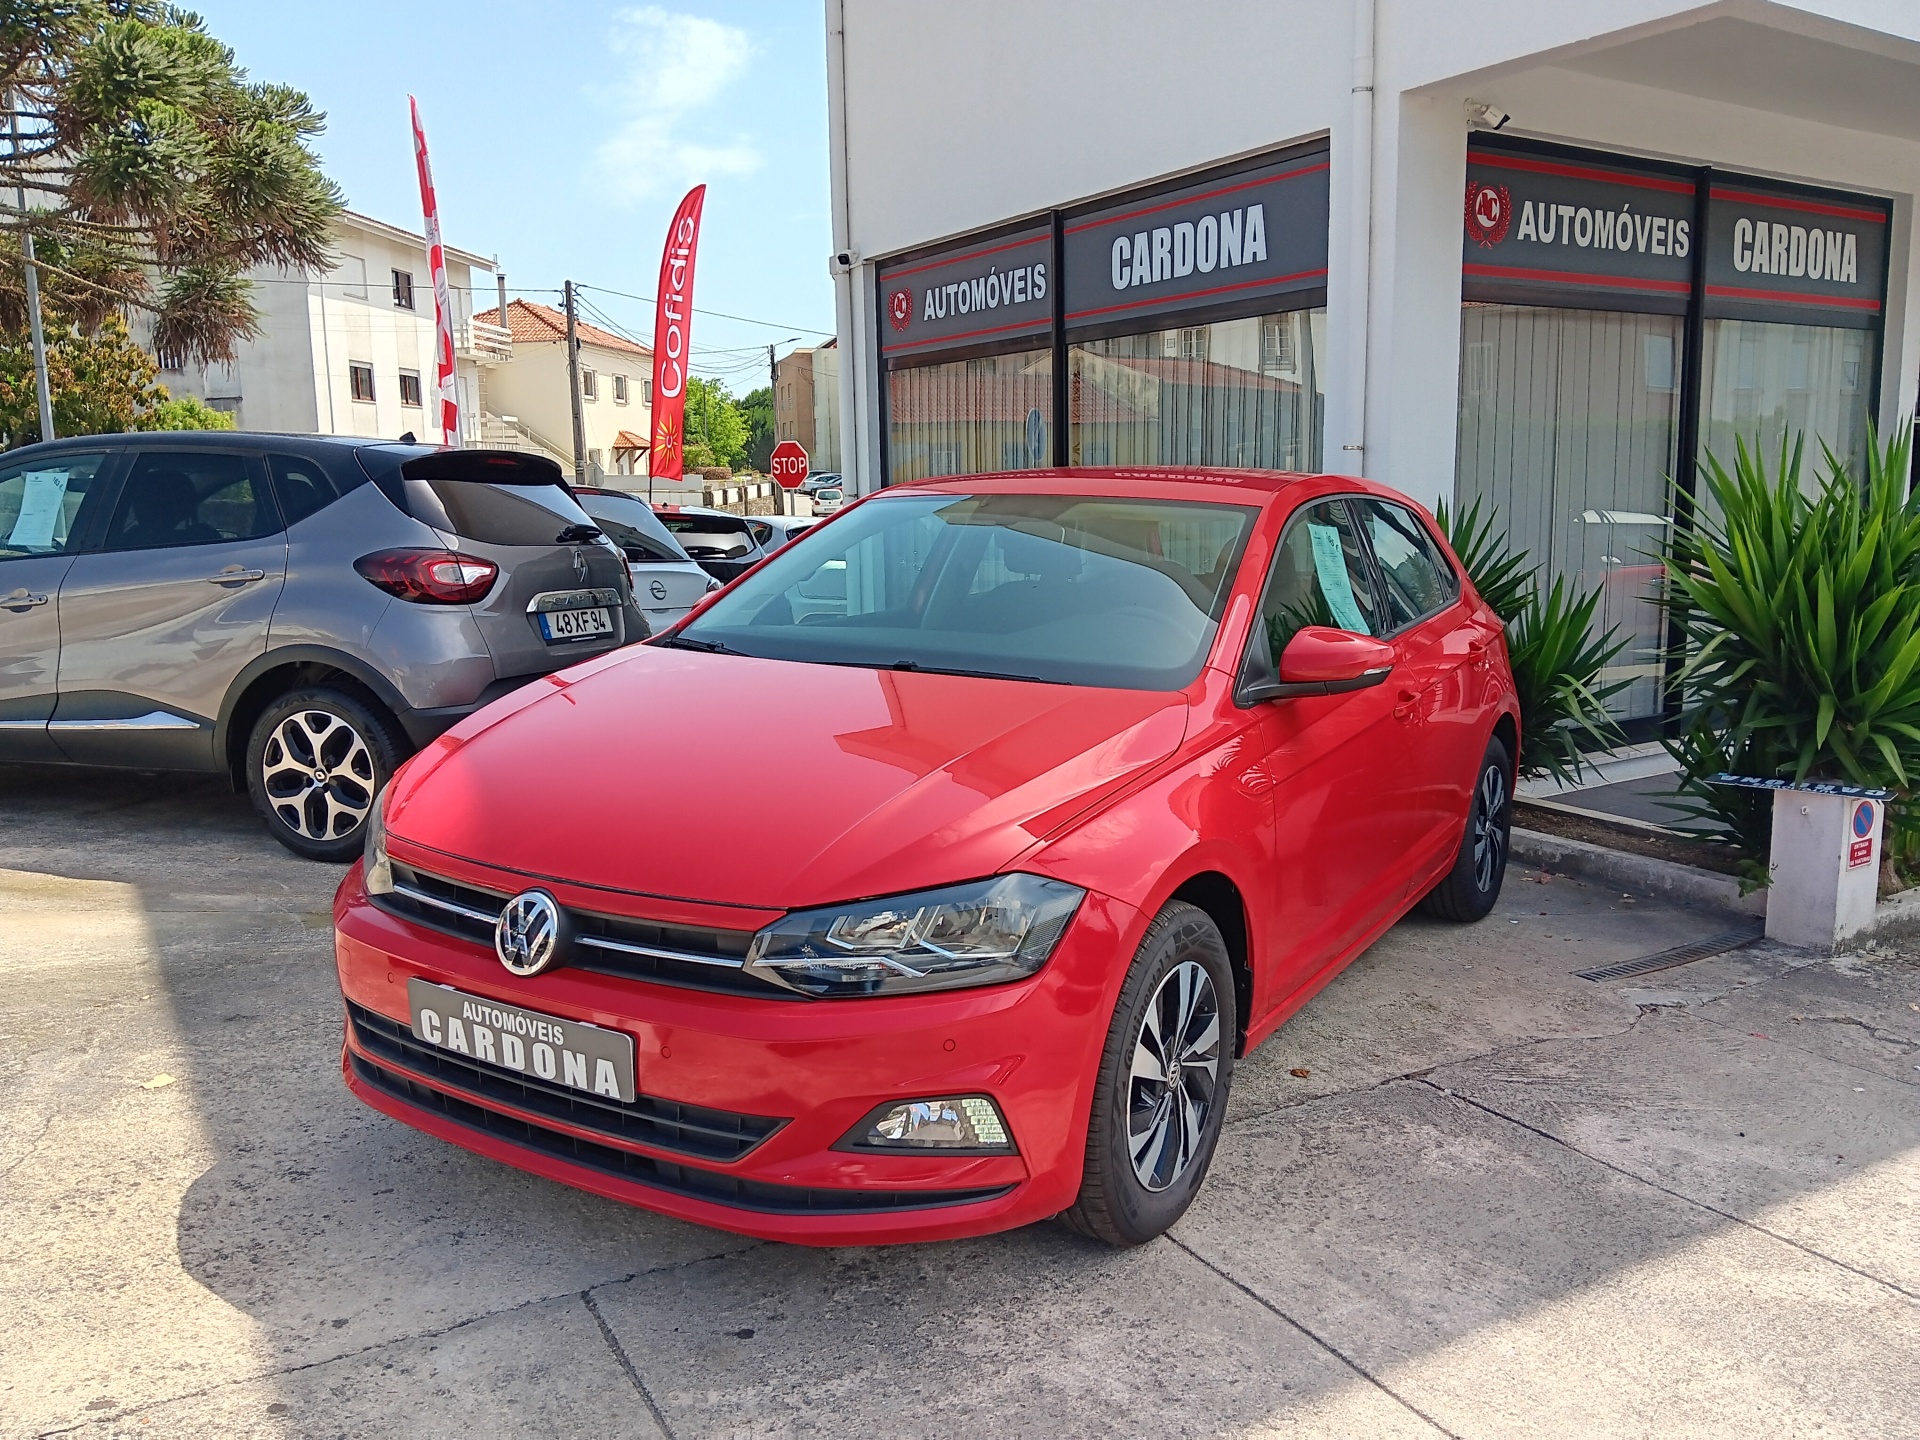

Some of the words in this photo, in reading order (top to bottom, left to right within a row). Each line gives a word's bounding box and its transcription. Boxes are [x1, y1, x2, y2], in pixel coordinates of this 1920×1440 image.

[923, 263, 1047, 321] AUTOMÓVEIS
[1111, 203, 1268, 290] CARDONA
[1517, 201, 1690, 258] AUTOMÓVEIS
[1733, 218, 1857, 284] CARDONA
[661, 217, 694, 398] Cofidis
[772, 456, 806, 475] STOP
[420, 1008, 621, 1099] CARDONA
[462, 1001, 564, 1046] AUTOMÓVEIS
